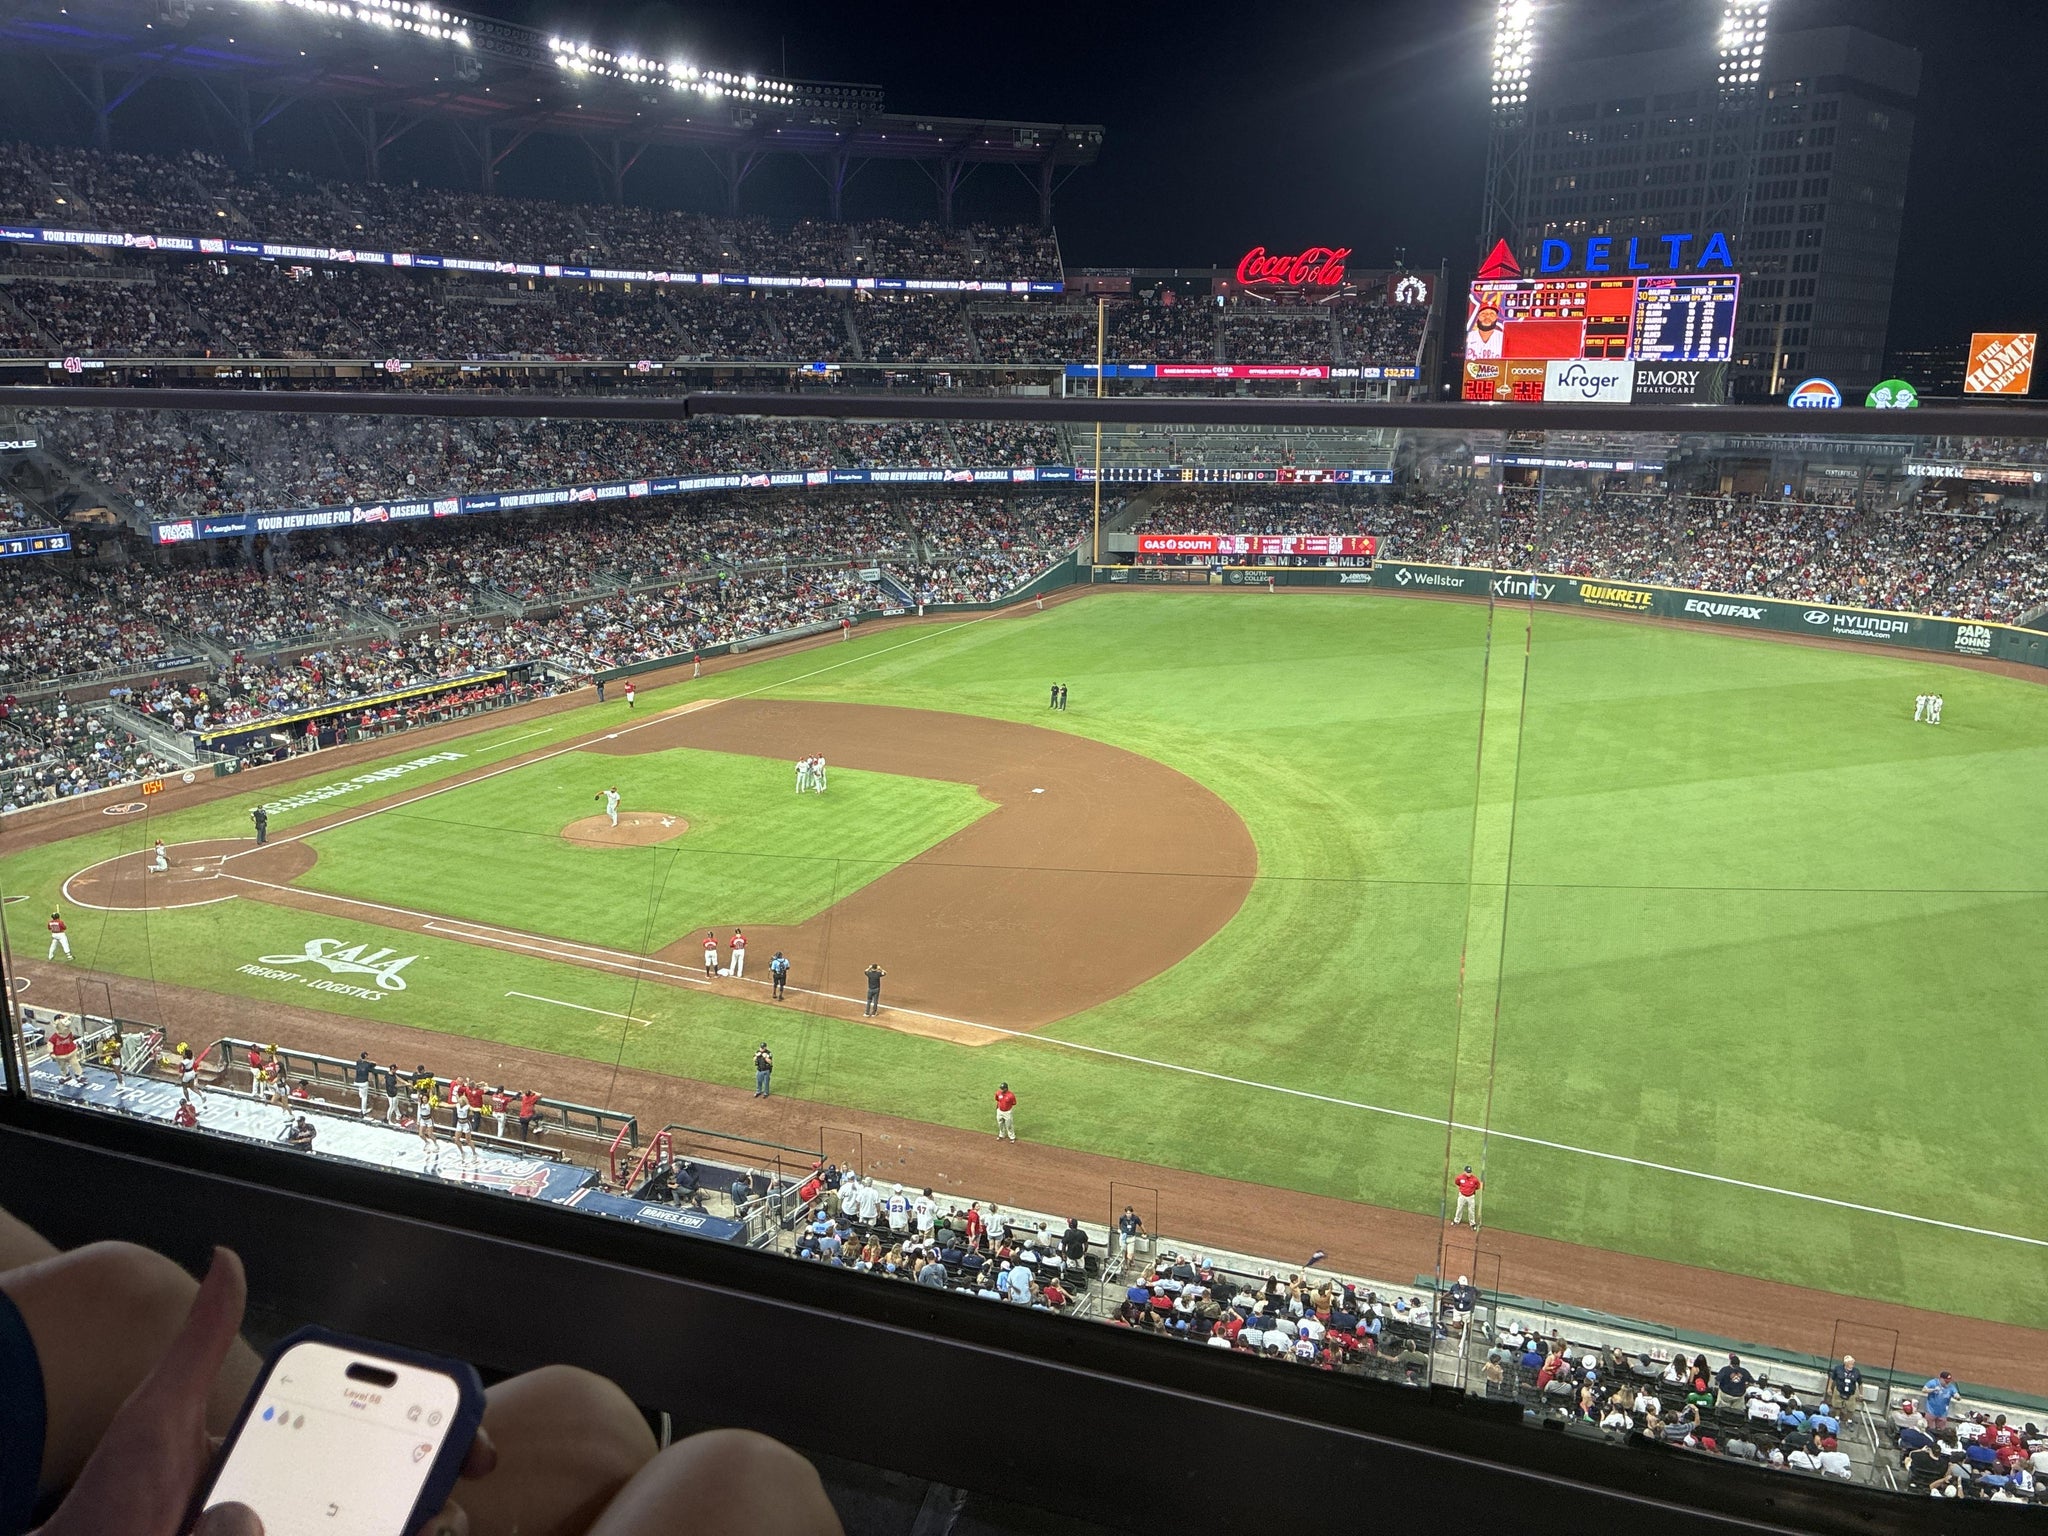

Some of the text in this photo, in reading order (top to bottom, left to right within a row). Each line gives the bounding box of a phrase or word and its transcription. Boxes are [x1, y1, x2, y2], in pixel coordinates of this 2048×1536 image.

[43, 230, 193, 250] YOUR NEW HOME FOR Braves BASEBALL
[264, 245, 282, 255] YOUR
[282, 246, 297, 256] NEW
[297, 247, 316, 258] HOME
[316, 248, 329, 259] FOR
[356, 251, 385, 262] BASEBALL
[1541, 232, 1733, 273] DELTA
[1976, 340, 2003, 362] THE
[64, 357, 82, 373] 41
[385, 359, 400, 372] 44
[1968, 334, 2034, 392] HOME
[1384, 367, 1415, 377] $32,512
[1637, 370, 1700, 386] EMORY
[1990, 356, 2032, 392] DEPOT
[1558, 364, 1619, 397] Kroger
[1466, 381, 1493, 394] 209
[1514, 382, 1543, 394] 232
[1794, 396, 1836, 408] Gulf
[679, 474, 803, 490] YOUR NEW HOME FOR Braves BASEBALL
[871, 470, 1008, 482] YOUR NEW HOME FOR Braves BASEBALL
[500, 486, 626, 507] YOUR NEW HOME FOR Braves BASEBALL
[257, 504, 429, 530] YOUR NEW HOME FOR Braves BASEBALL
[158, 524, 193, 534] BRAVES
[160, 530, 194, 540] VISION
[212, 525, 231, 533] Georgia
[11, 542, 22, 552] 71
[51, 538, 64, 548] 23
[1144, 540, 1212, 550] GAS SOUTH
[1218, 541, 1232, 550] AL
[1205, 555, 1235, 565] MLB+
[1278, 556, 1308, 565] MB+
[1340, 557, 1371, 566] MLB+
[1414, 572, 1464, 587] Wellstar
[1493, 576, 1556, 599] xfinity
[1580, 584, 1653, 604] QUIKRETE
[1684, 599, 1762, 620] EQUIFAX
[1833, 614, 1908, 633] HYUNDAI
[1832, 626, 1890, 639] HyundaiUSA.com
[1957, 625, 1990, 639] PAPA
[1955, 636, 1990, 648] JOHNS
[351, 751, 468, 782] Harrah's
[236, 964, 388, 1001] FREIGHT LOGISTICS
[86, 1082, 106, 1092] TO
[112, 1086, 180, 1110] TRUIS
[892, 1204, 903, 1213] 23
[917, 1206, 927, 1214] 47
[642, 1207, 705, 1228] BRAVES.COM
[344, 1388, 369, 1401] Level
